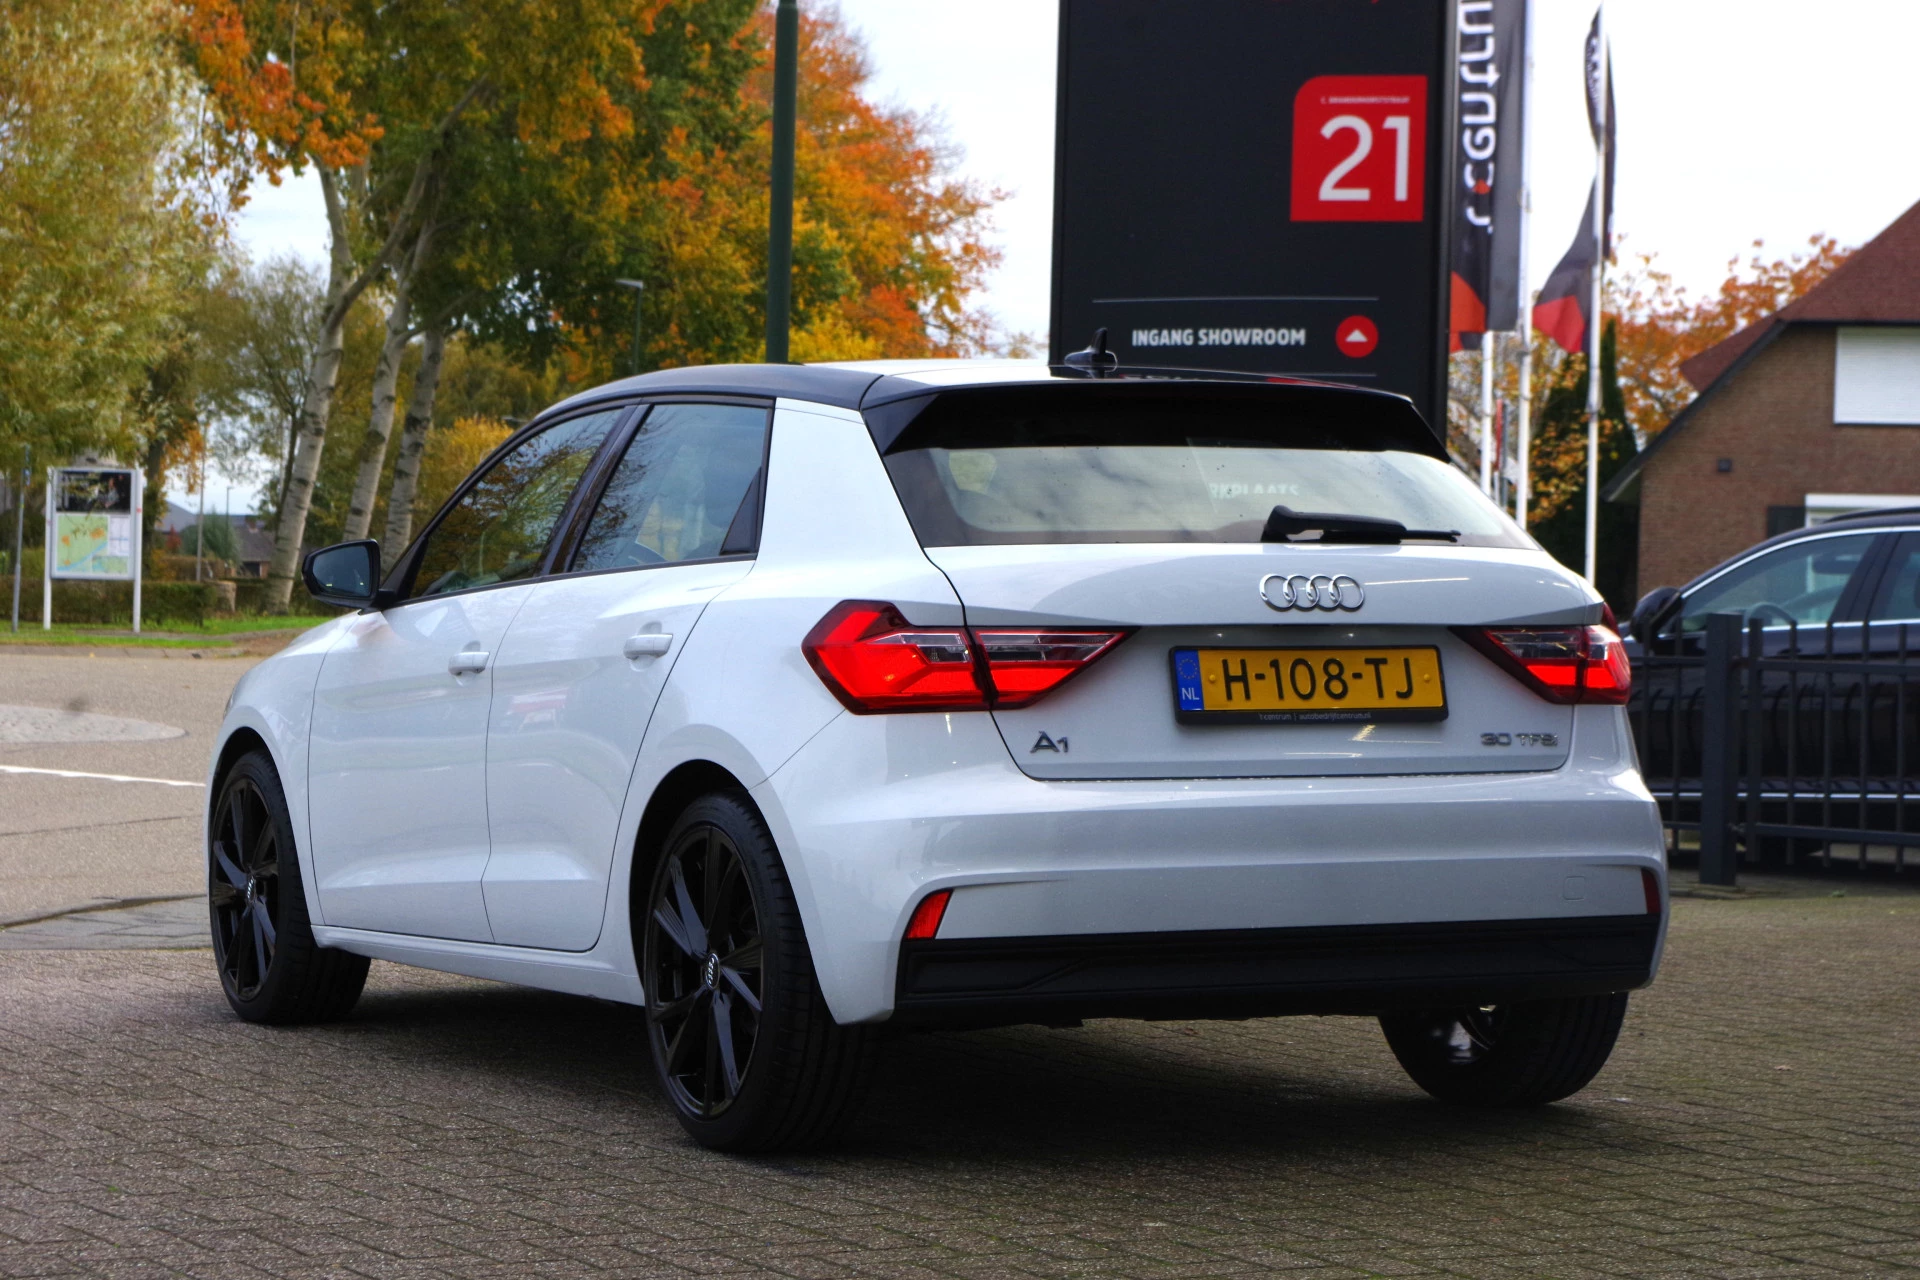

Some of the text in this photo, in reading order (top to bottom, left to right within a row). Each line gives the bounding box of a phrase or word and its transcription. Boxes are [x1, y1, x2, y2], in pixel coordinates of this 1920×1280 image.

[1319, 114, 1411, 202] 21
[1132, 328, 1306, 346] INGANG SHOWROOM
[1222, 657, 1414, 701] H-108-TJ
[1181, 687, 1200, 700] NL
[1030, 731, 1069, 753] A1
[1480, 732, 1512, 746] 30
